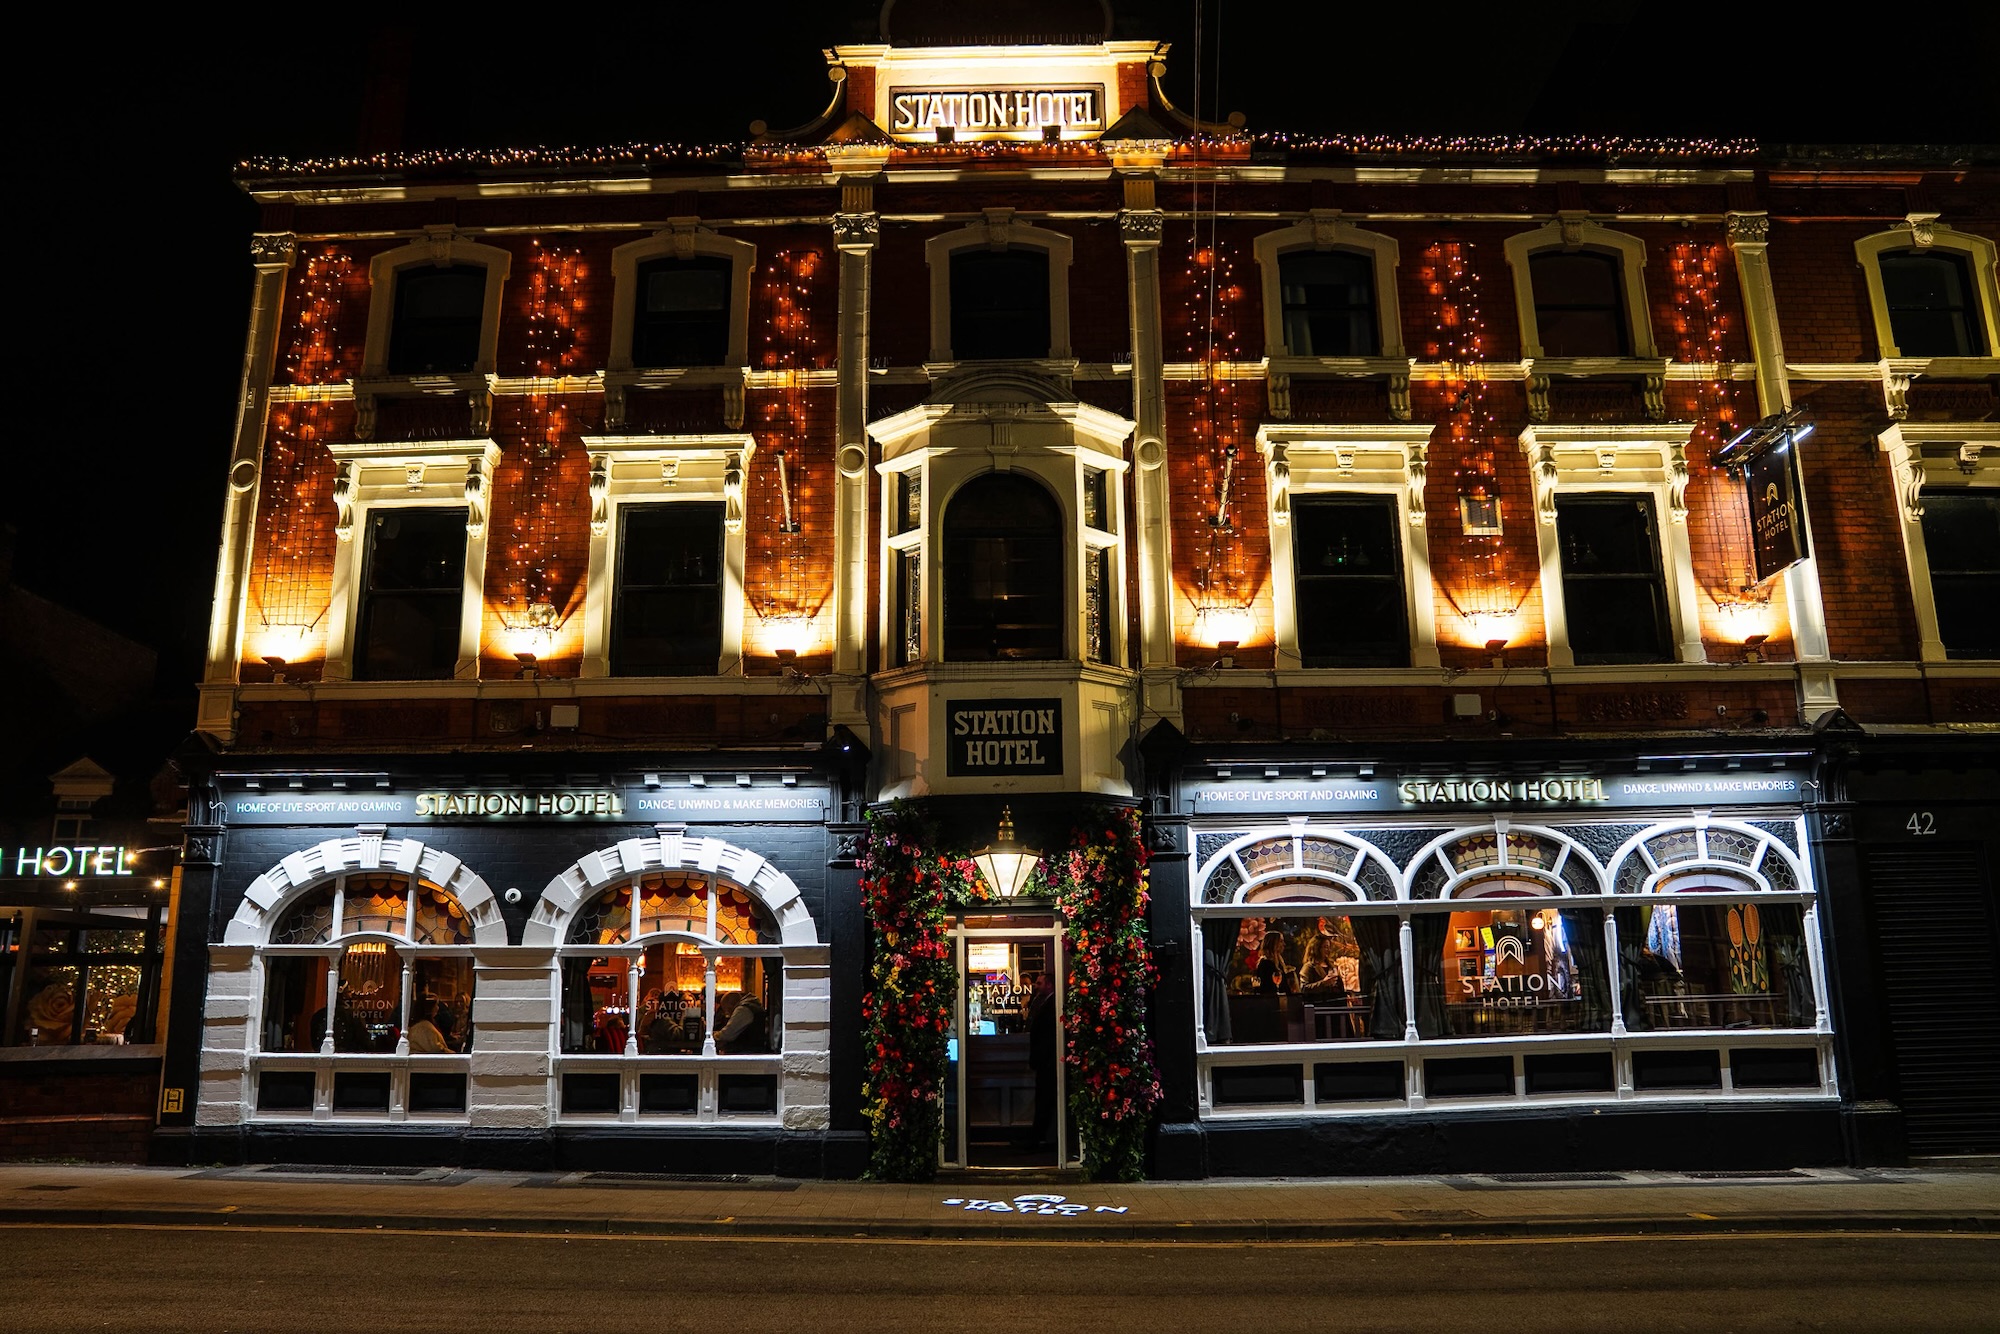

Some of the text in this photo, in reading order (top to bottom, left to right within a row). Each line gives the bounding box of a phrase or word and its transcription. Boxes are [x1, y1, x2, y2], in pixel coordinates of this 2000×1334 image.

[1756, 499, 1795, 532] STATION
[1764, 520, 1788, 540] HOTEL
[954, 709, 1055, 735] STATION
[966, 740, 1045, 765] HOTEL
[1402, 778, 1610, 803] STATION HOTEL
[1623, 780, 1796, 794] DANCE, UNWIND & MAKE MEMORIES
[1202, 789, 1378, 801] HOME OF LIVE SPORT AND GAMING
[236, 801, 402, 813] HOME OF LIVE SPORT AND GAMING
[415, 792, 624, 816] STATION HOTEL
[638, 798, 819, 810] DANCE, UNWIND & MAKE MEMORIES
[1906, 812, 1937, 835] 42
[16, 846, 133, 875] HOTEL
[977, 984, 1033, 995] STATION
[1462, 973, 1563, 994] STATION
[344, 1000, 394, 1010] STATION
[645, 1000, 698, 1011] STATION
[987, 996, 1022, 1004] HOTEL
[1483, 996, 1542, 1010] HOTEL
[352, 1010, 384, 1019] HOTEL
[655, 1011, 687, 1020] HOTE
